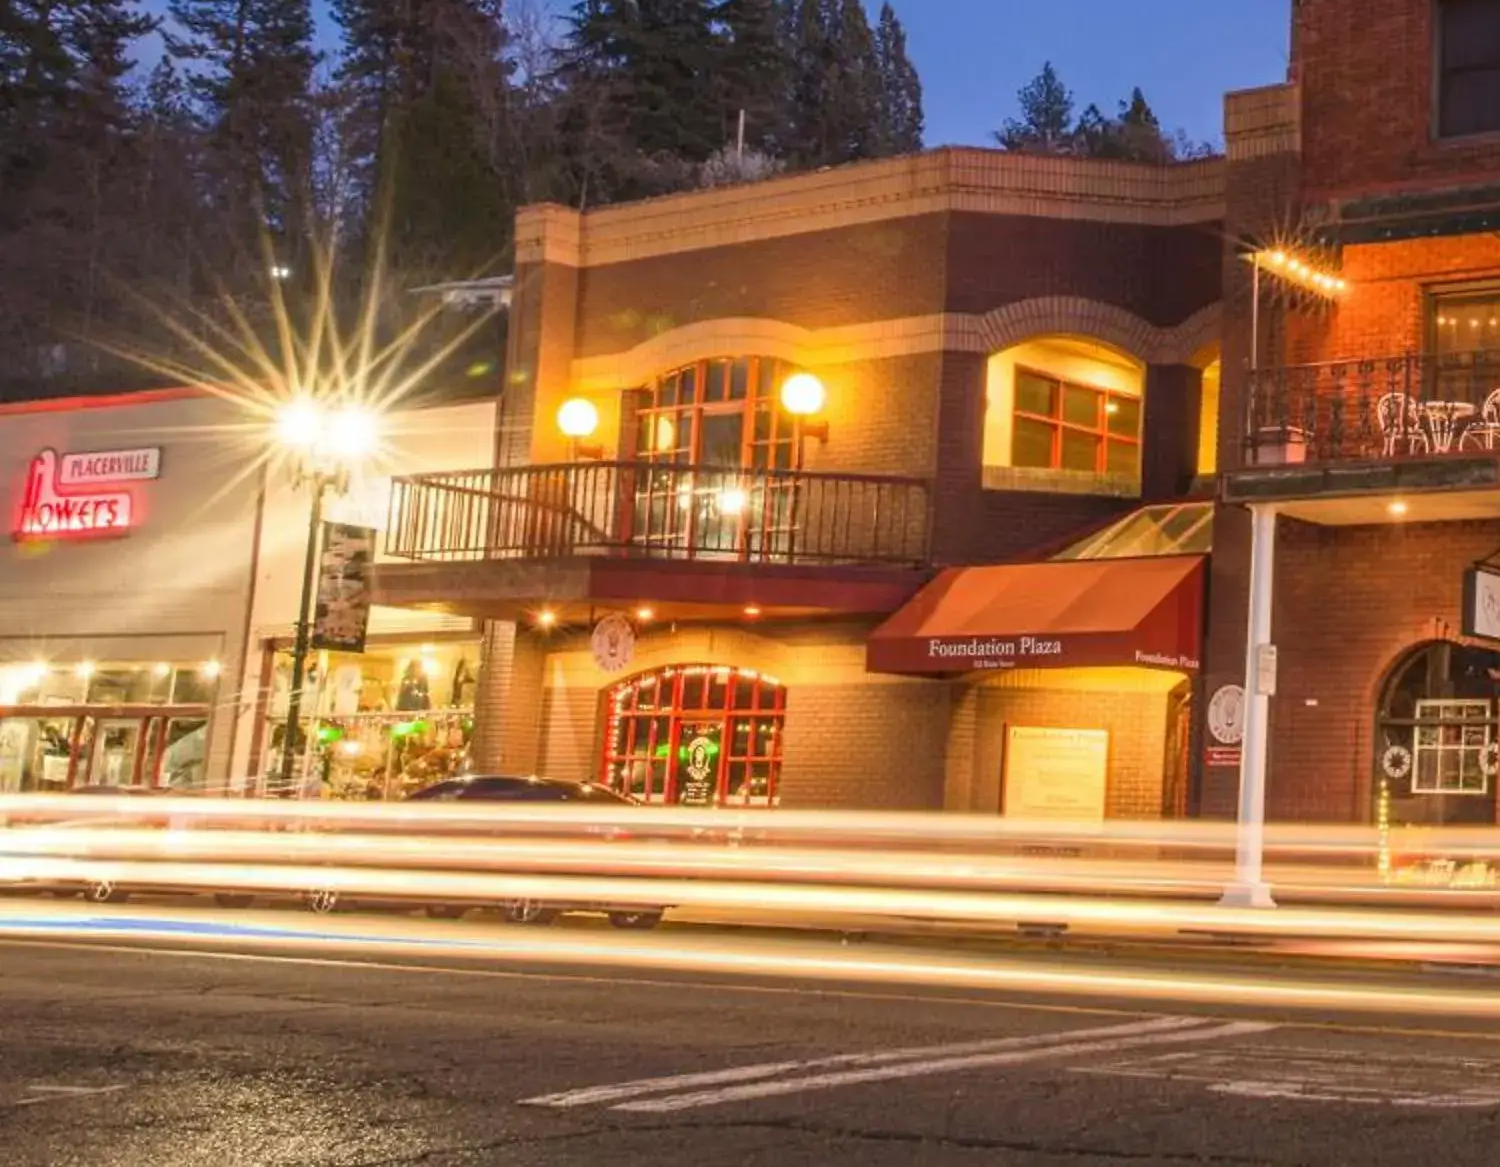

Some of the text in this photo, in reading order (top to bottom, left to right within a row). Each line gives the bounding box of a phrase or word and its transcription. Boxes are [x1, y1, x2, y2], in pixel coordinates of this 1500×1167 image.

[71, 454, 151, 478] PLACERVILLE
[928, 636, 1062, 658] Foundation Plaza
